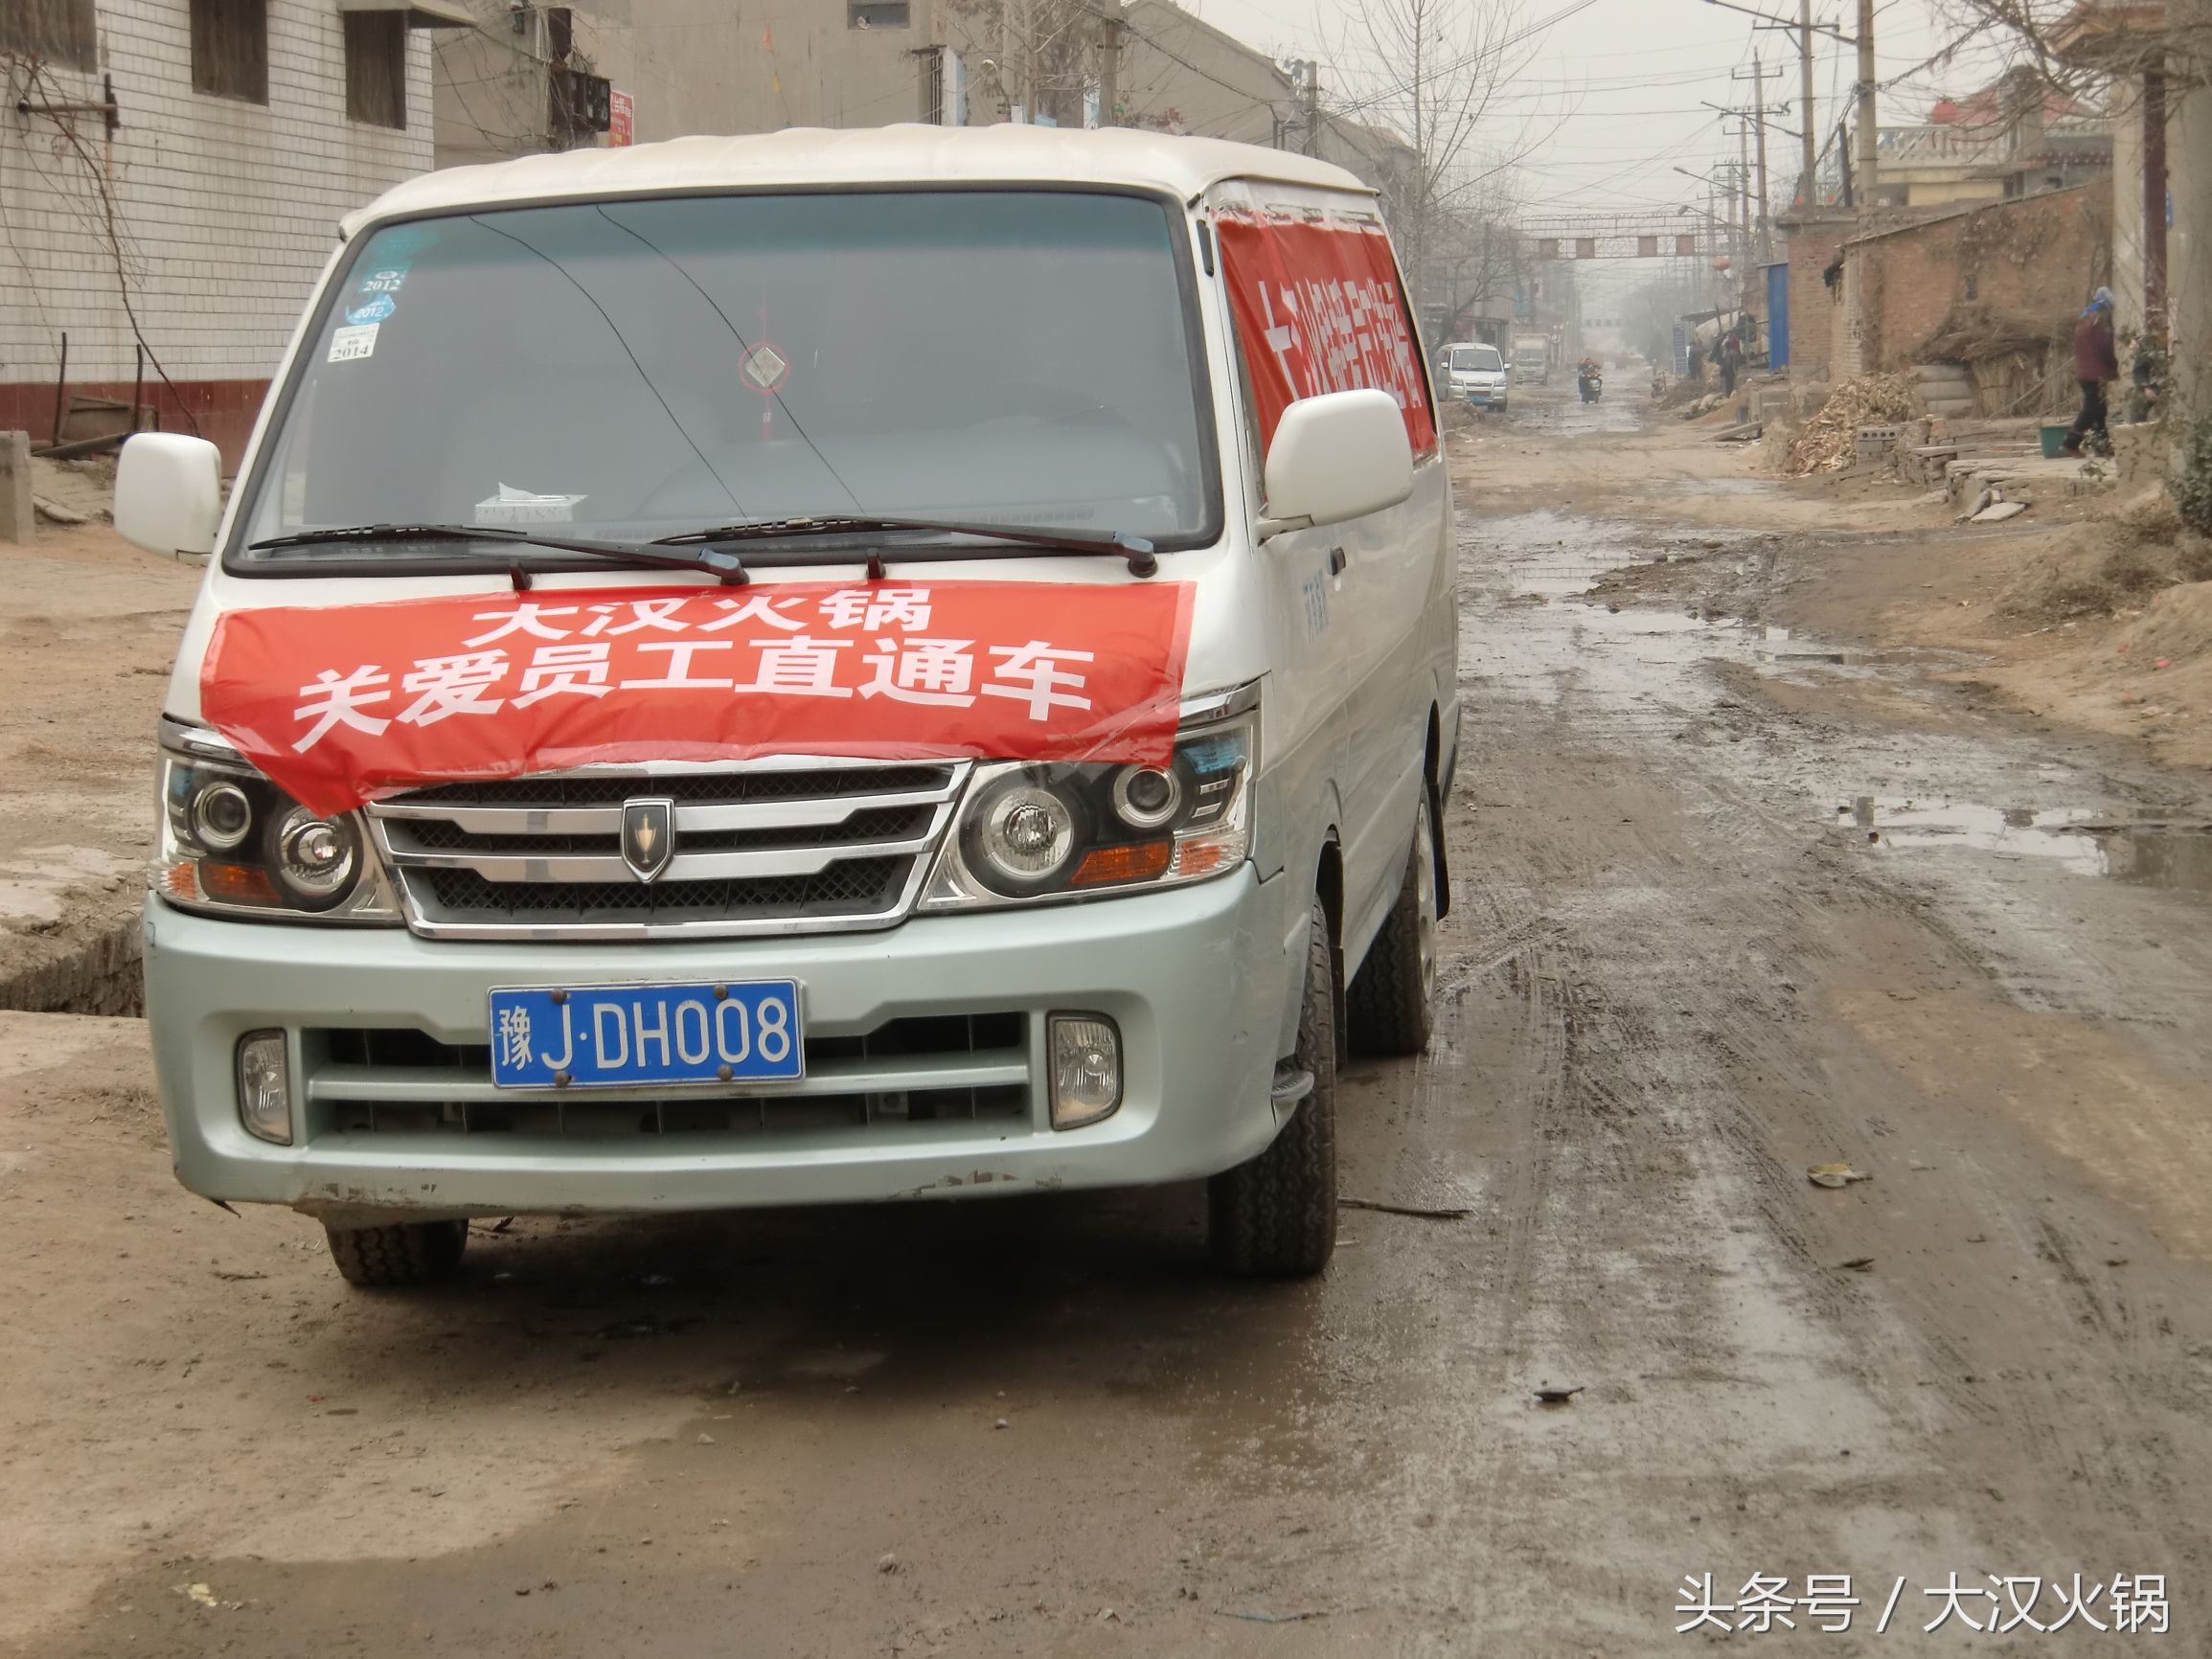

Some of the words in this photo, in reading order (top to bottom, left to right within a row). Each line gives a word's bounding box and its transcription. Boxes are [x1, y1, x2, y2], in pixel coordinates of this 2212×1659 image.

[363, 279, 401, 291] 2012
[331, 345, 370, 360] 2014
[462, 588, 932, 648] 大汉火锅
[291, 633, 1094, 754] 关爱员工直通车
